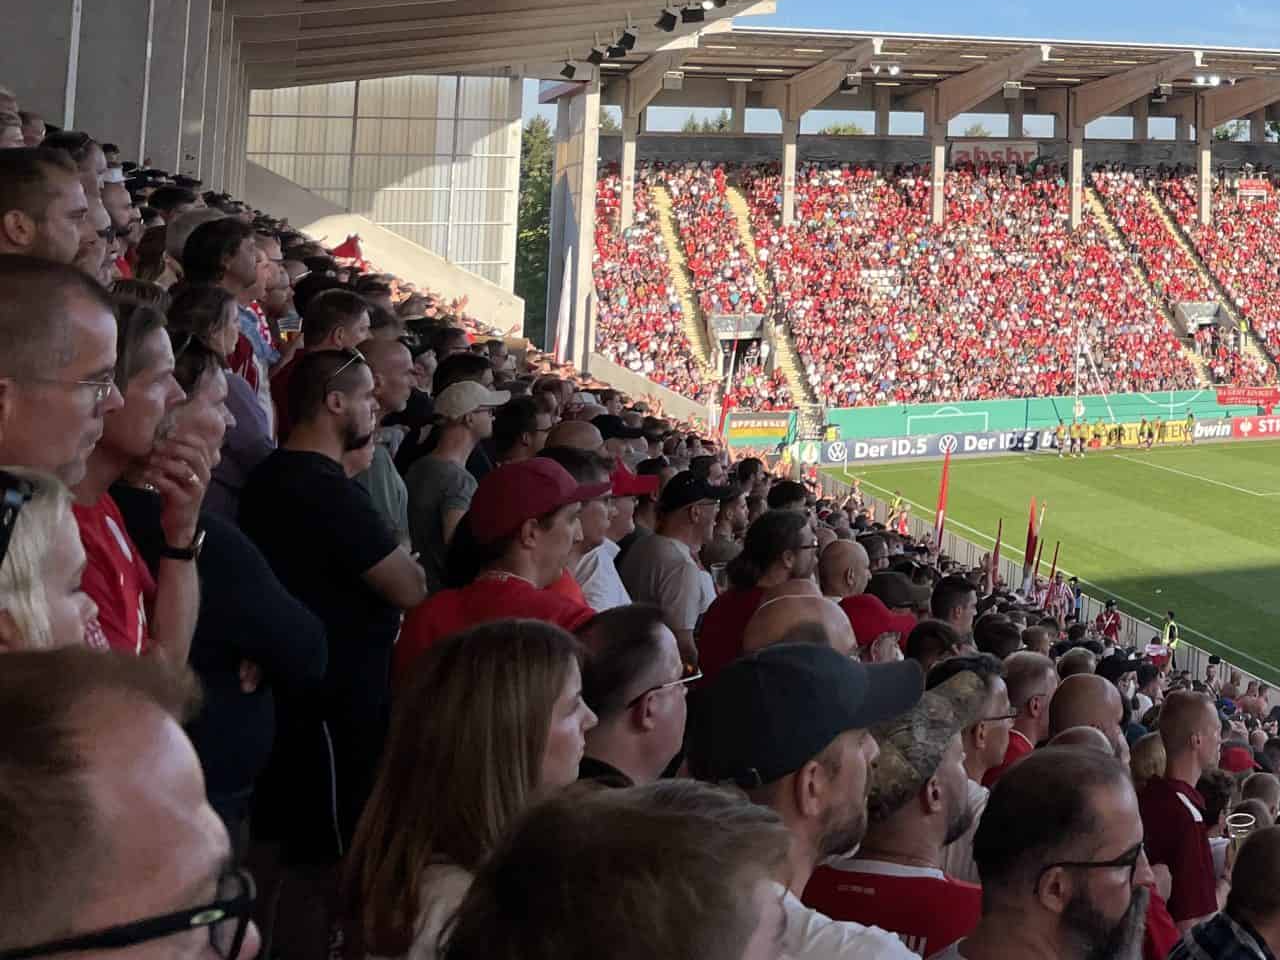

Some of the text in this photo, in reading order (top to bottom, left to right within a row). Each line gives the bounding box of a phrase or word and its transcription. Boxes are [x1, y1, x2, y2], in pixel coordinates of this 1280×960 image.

[1194, 420, 1230, 438] bwin
[855, 439, 927, 458] Der ID.5
[964, 435, 994, 451] Der
[999, 431, 1033, 449] ID.5
